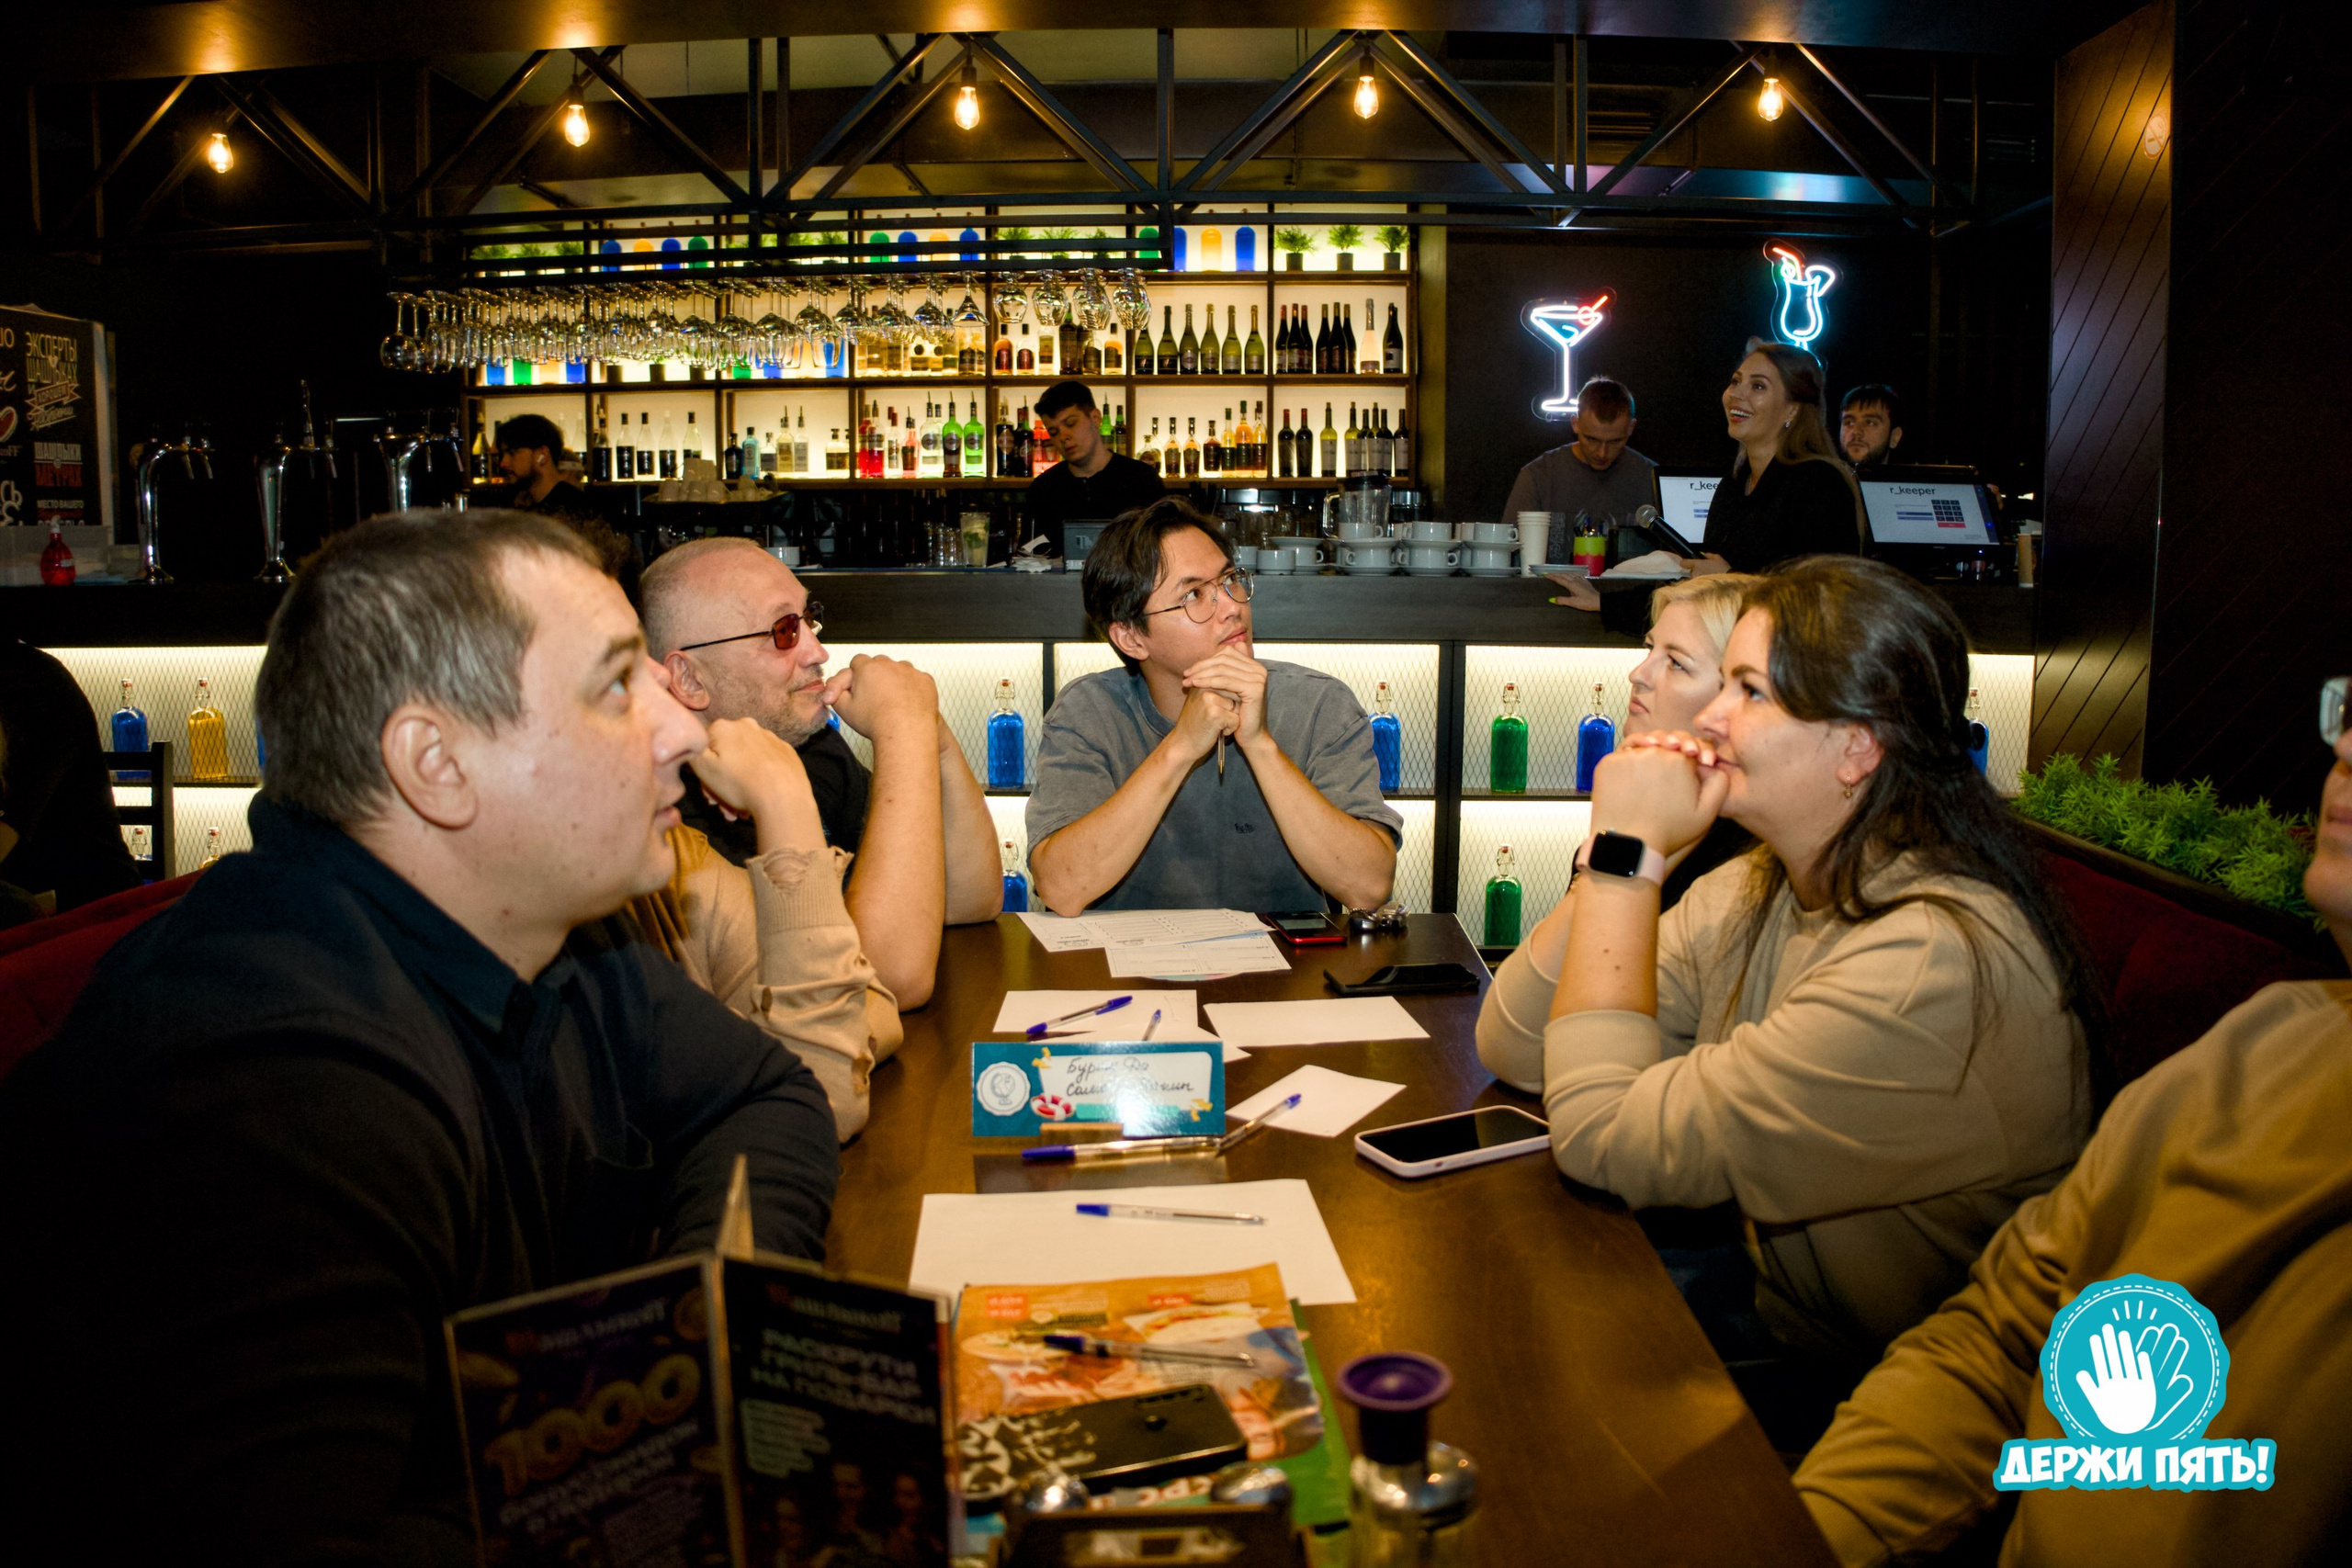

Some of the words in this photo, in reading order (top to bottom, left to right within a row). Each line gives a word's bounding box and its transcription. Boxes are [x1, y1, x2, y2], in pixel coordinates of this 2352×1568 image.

[25, 331, 77, 363] ЭКСПЕРТЫ
[1889, 485, 1936, 497] r_keeper
[37, 499, 59, 509] МЕСТО
[60, 500, 85, 510] ВАШЕГО
[482, 1352, 702, 1496] 1000
